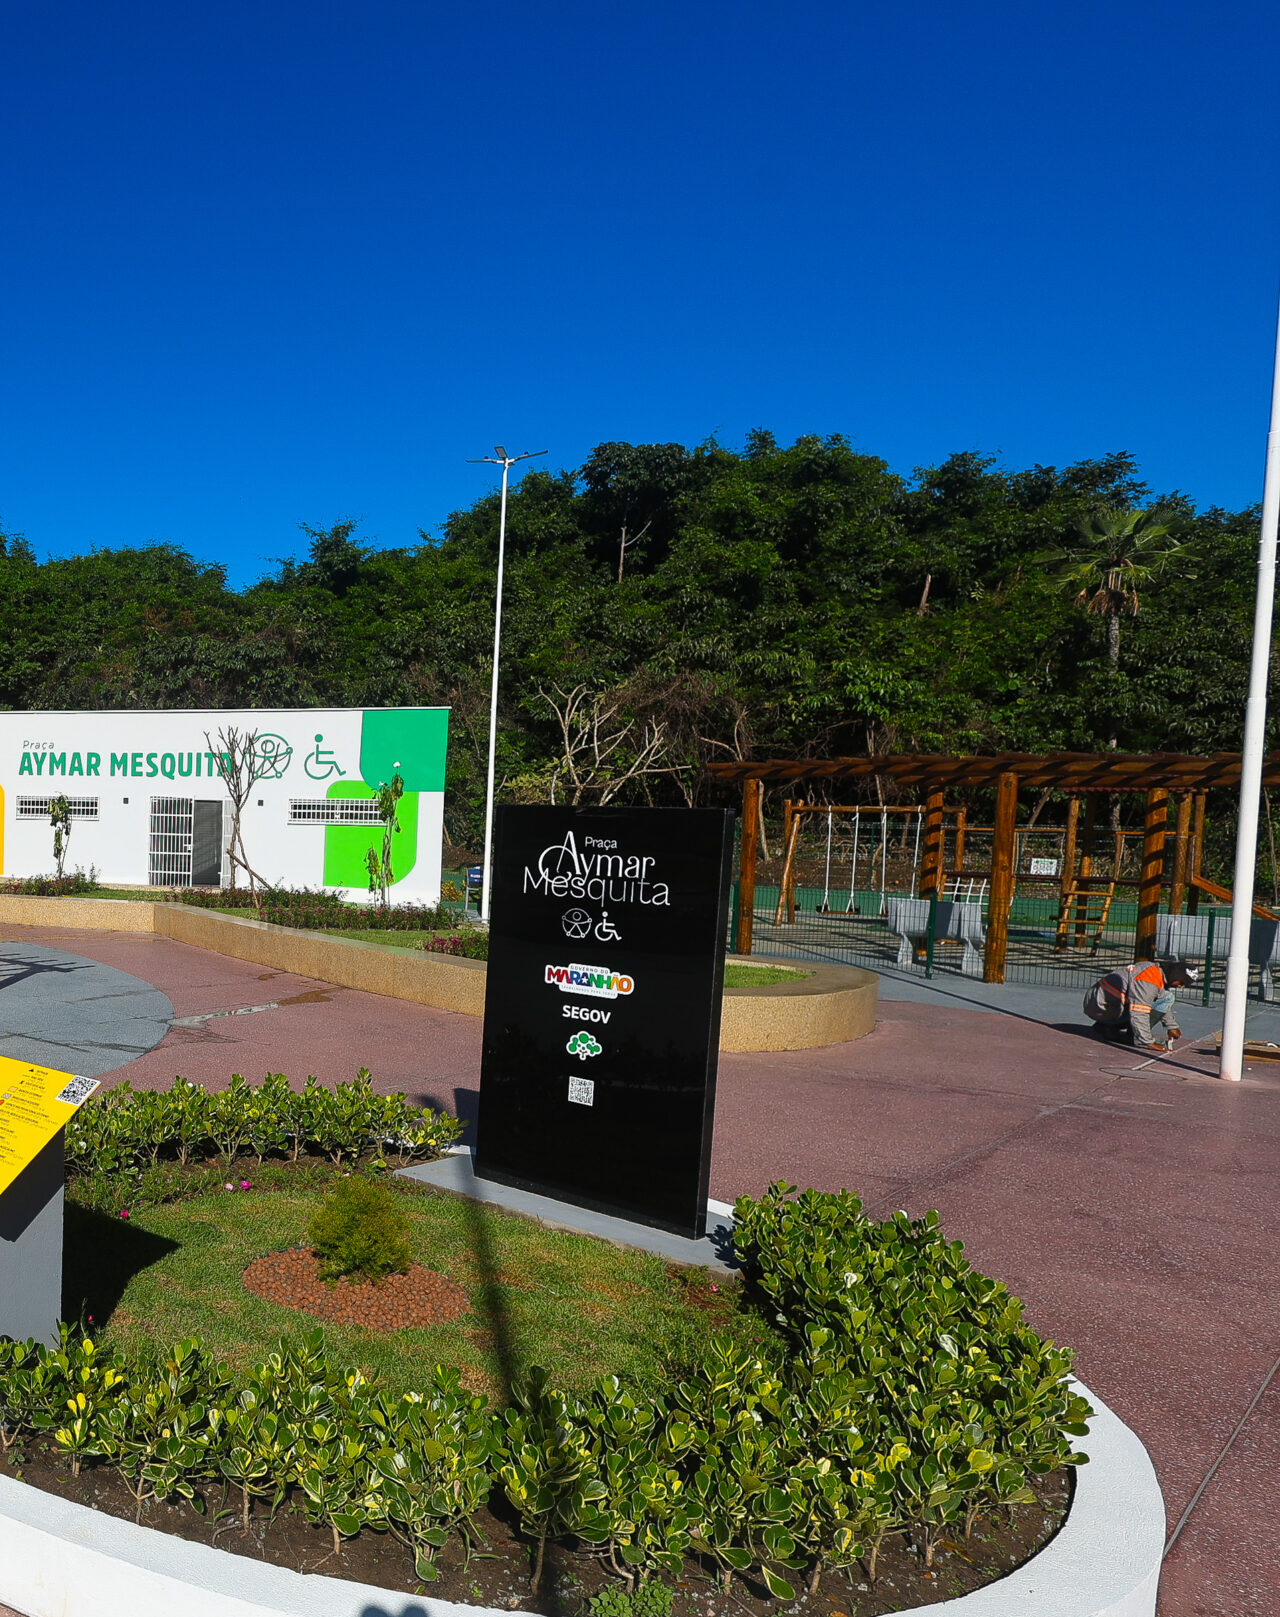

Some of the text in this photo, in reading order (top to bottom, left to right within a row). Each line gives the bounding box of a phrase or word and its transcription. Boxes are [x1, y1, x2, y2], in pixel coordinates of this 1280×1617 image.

[23, 740, 55, 751] Praça
[19, 752, 233, 780] AYMAR MESQUITA
[585, 836, 618, 850] Praça
[538, 830, 656, 887] Aymar
[523, 866, 671, 907] Mesquita
[547, 967, 632, 993] MARANHÃO
[562, 1005, 611, 1024] SEGOV
